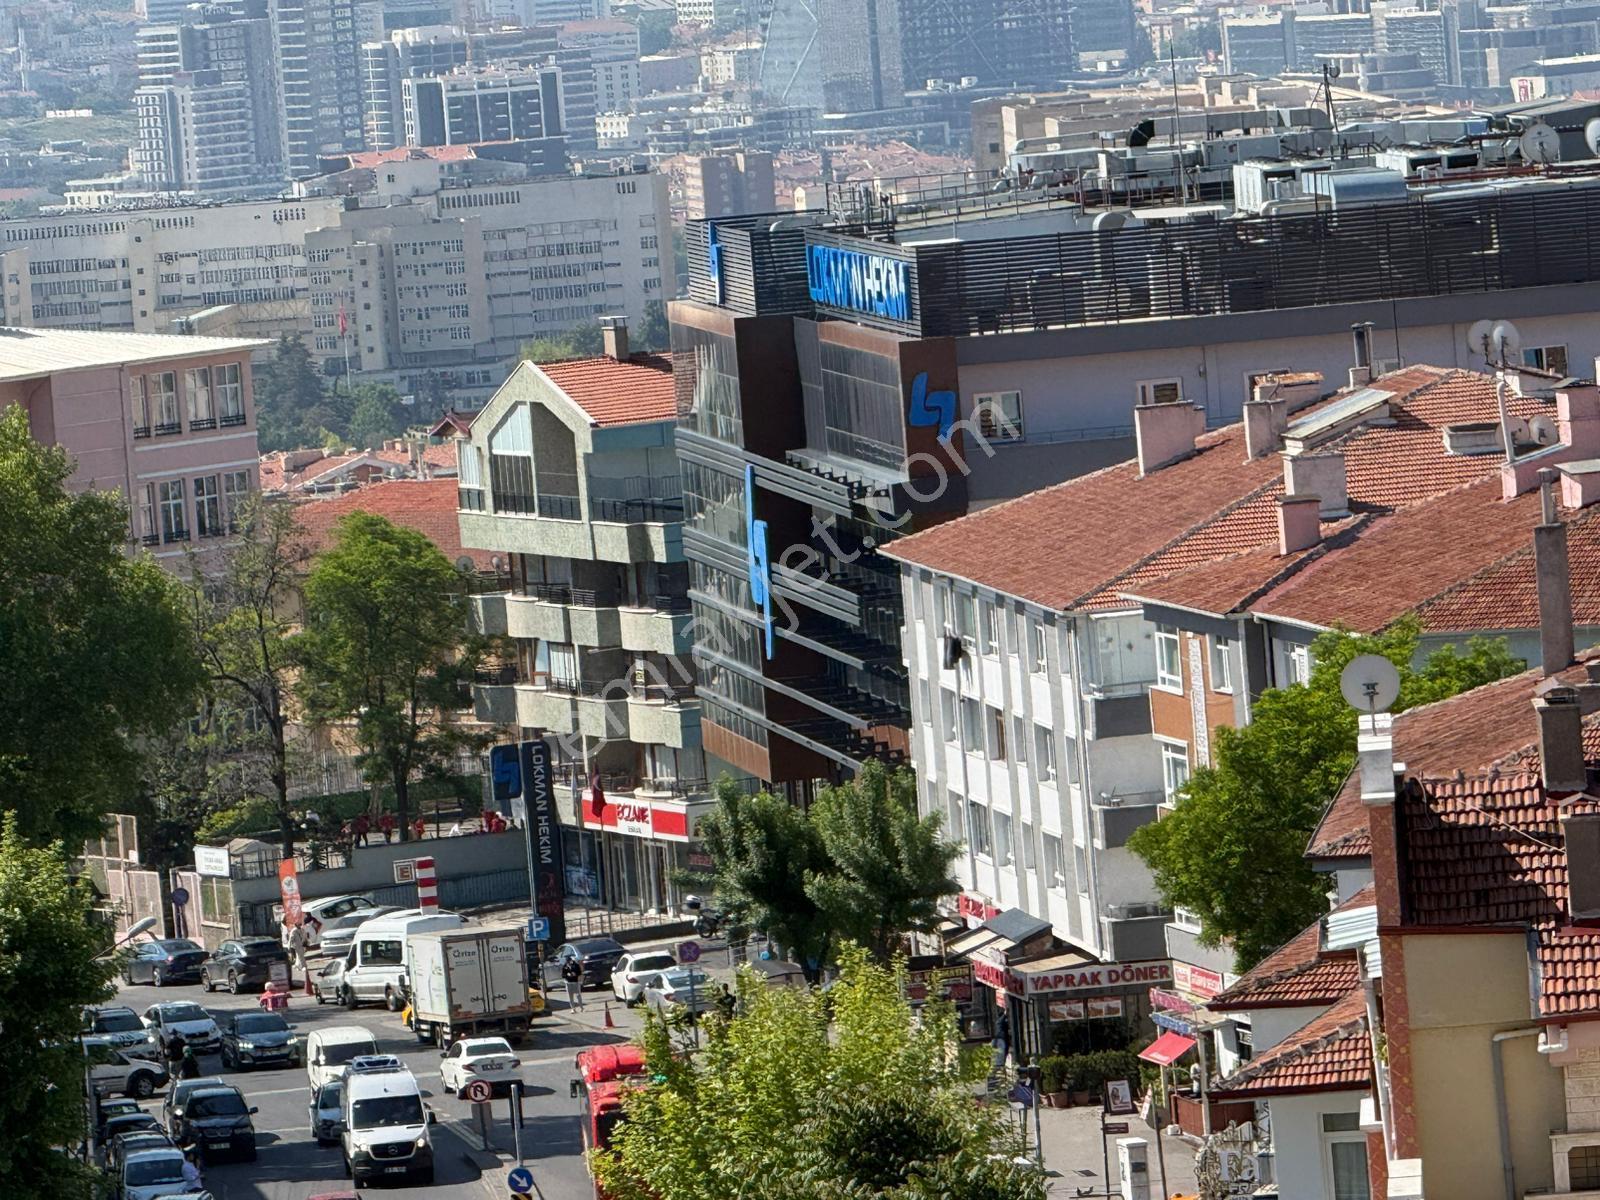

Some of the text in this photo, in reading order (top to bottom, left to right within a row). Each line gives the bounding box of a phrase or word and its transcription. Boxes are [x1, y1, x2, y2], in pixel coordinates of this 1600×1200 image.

[532, 745, 548, 811] LOKMAN
[532, 920, 544, 938] P
[1031, 971, 1102, 992] YAPRAK
[1106, 964, 1171, 984] DÖNER
